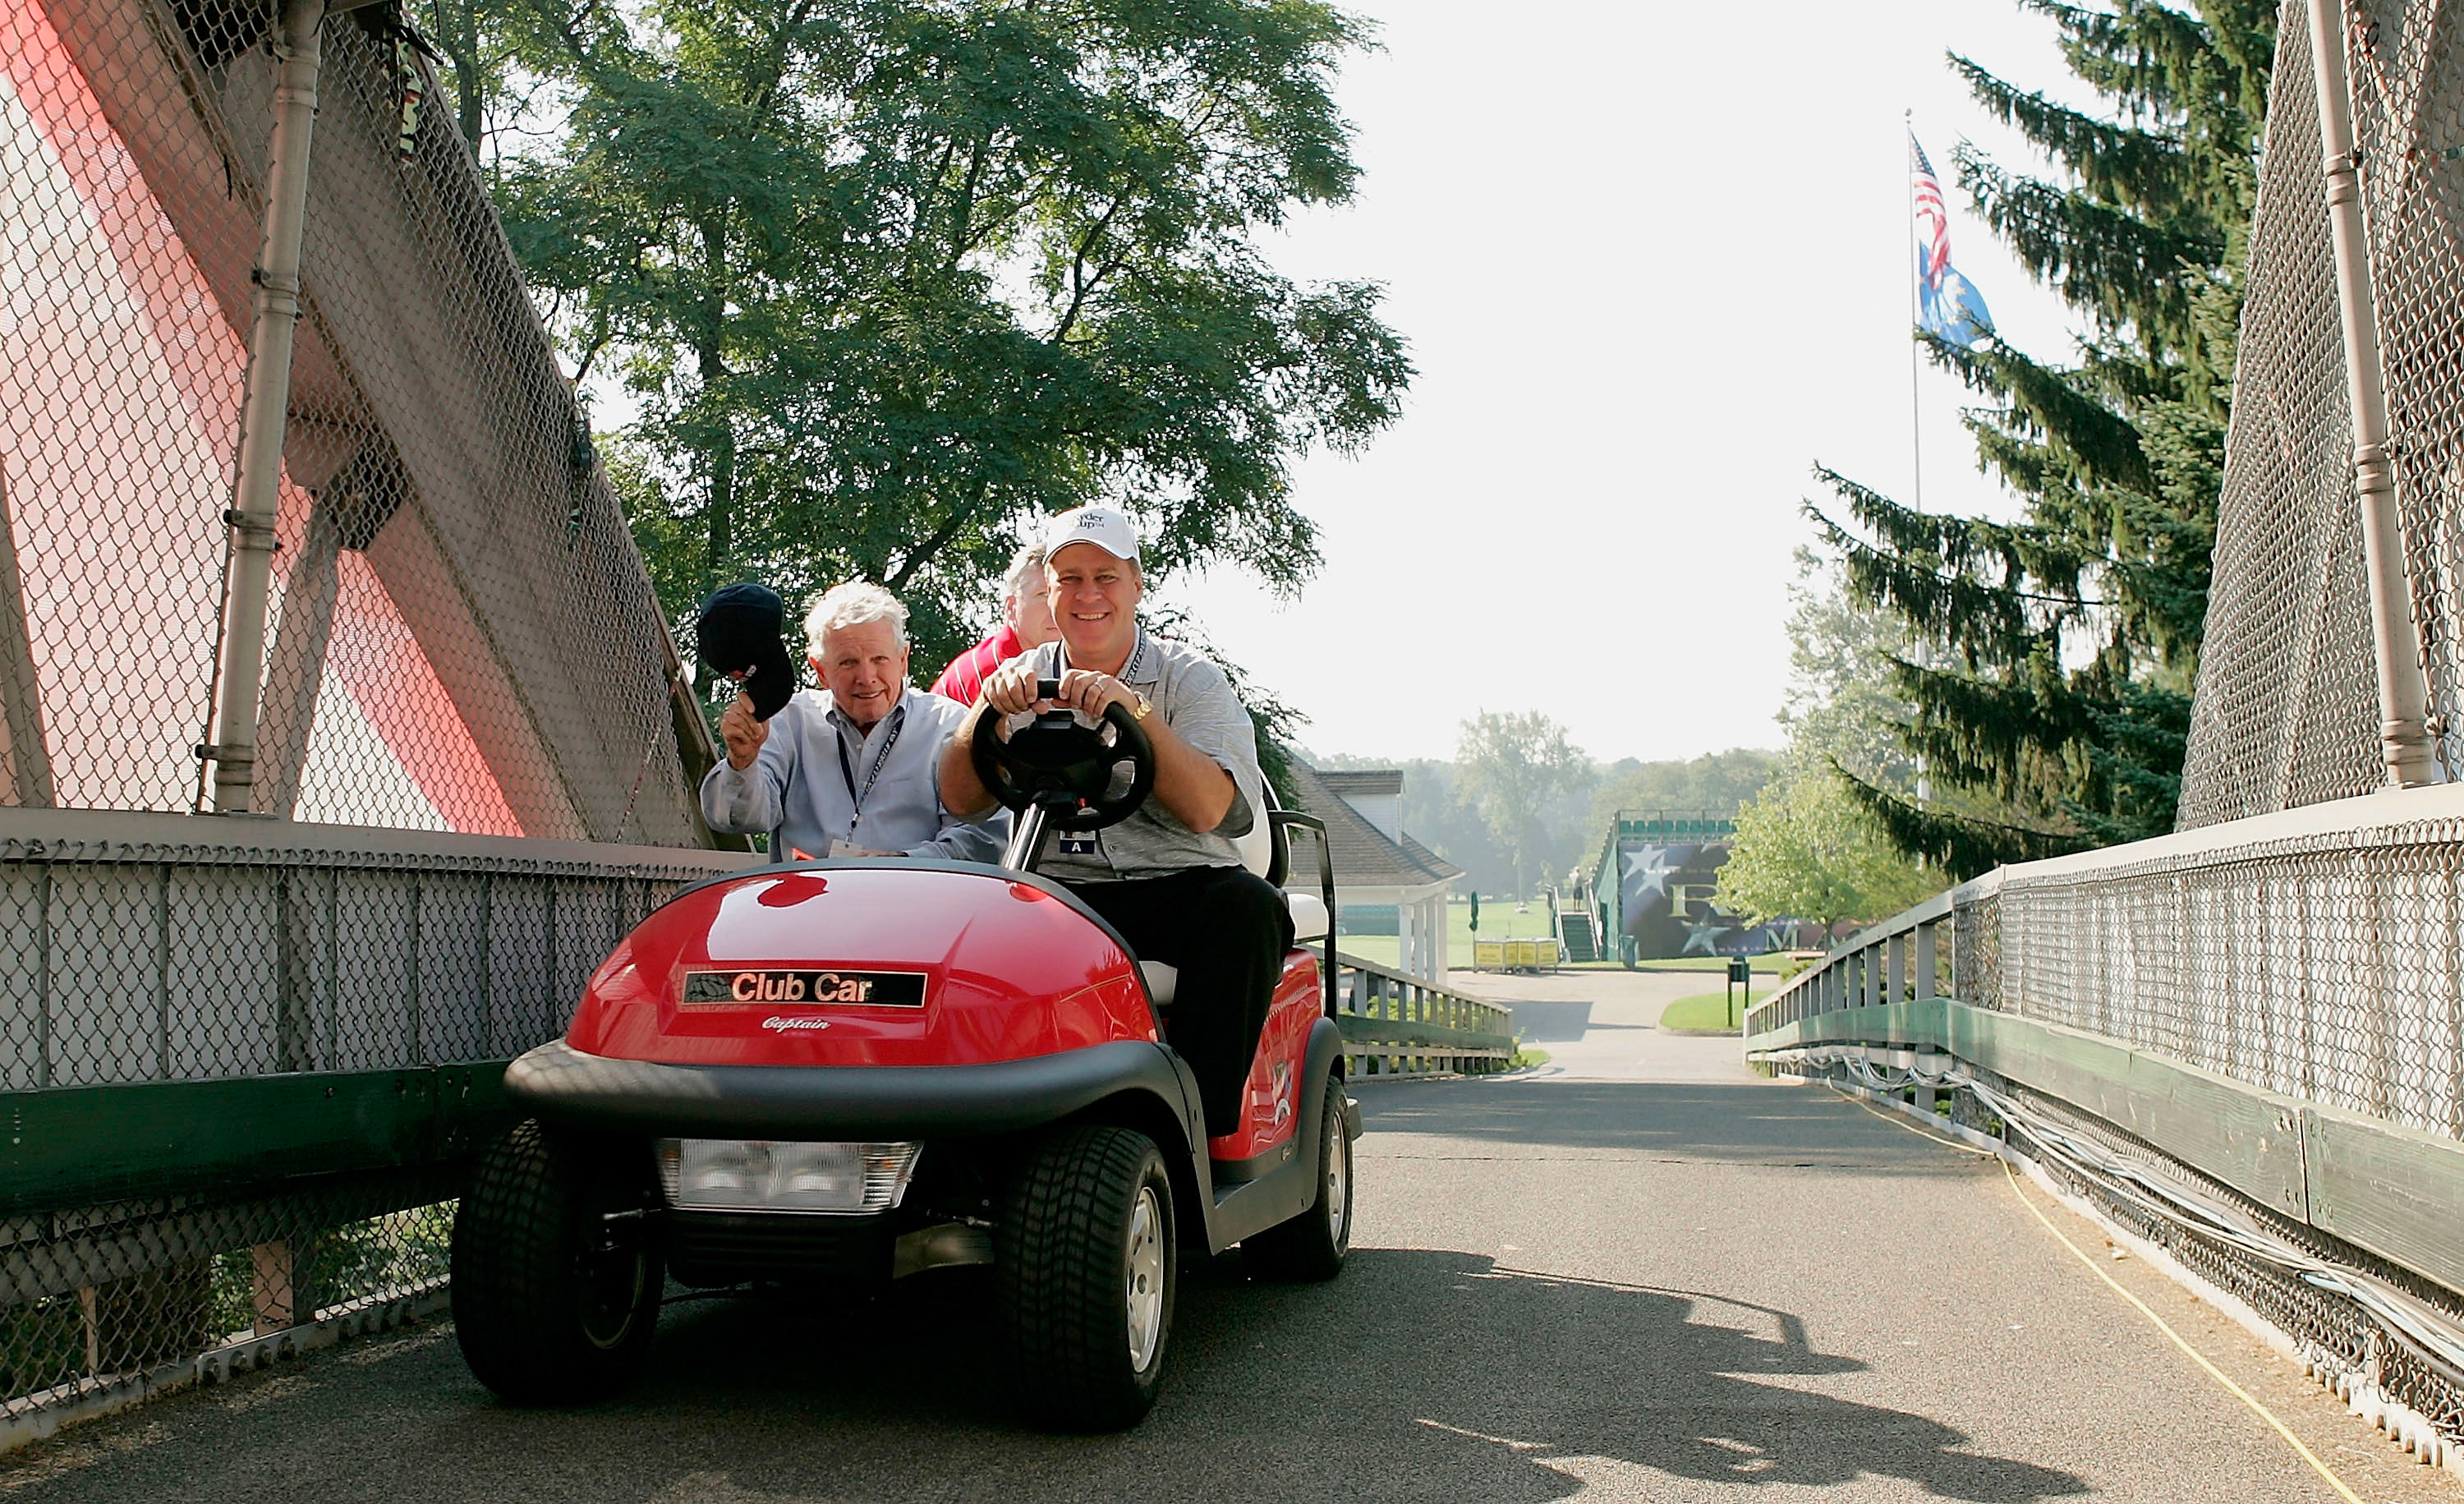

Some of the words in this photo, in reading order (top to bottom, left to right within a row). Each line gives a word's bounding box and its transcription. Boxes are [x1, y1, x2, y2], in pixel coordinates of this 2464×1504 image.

[1071, 841, 1082, 852] A
[732, 973, 805, 1001] Club
[814, 973, 873, 1001] Car
[761, 1016, 830, 1033] Captain
